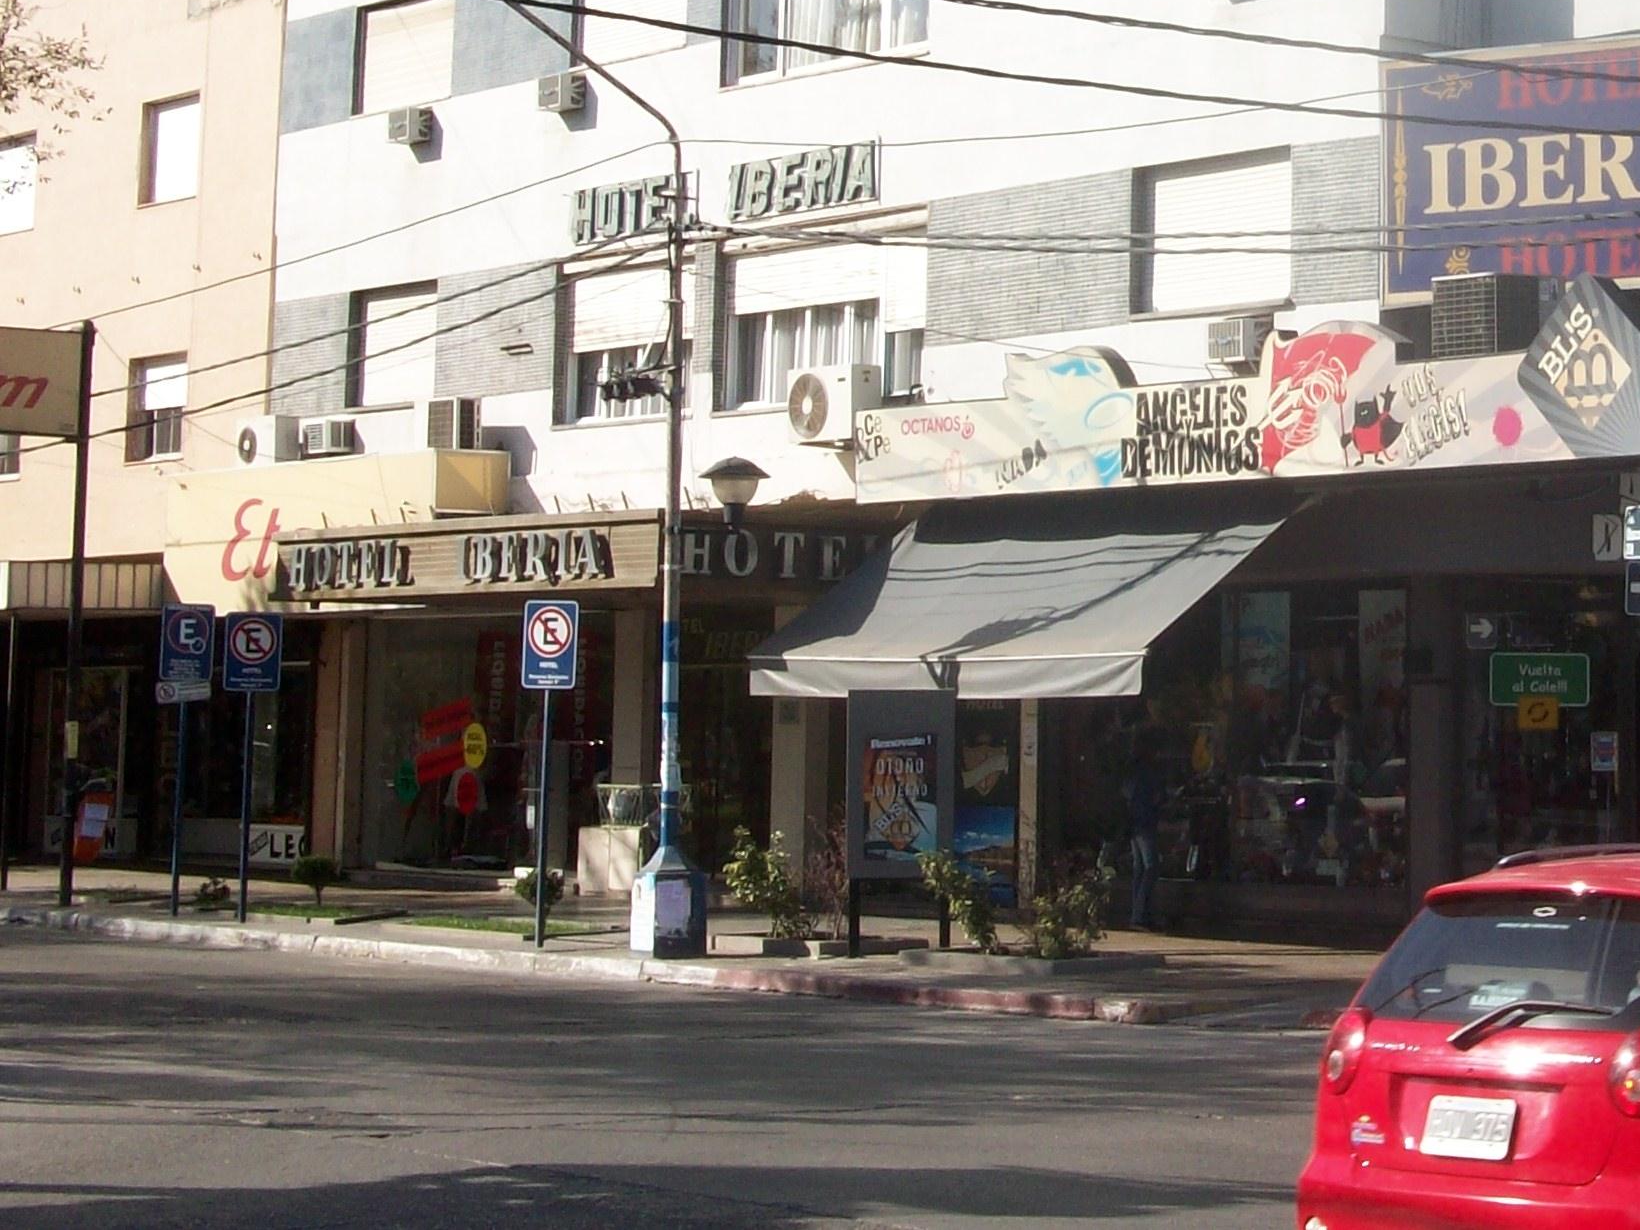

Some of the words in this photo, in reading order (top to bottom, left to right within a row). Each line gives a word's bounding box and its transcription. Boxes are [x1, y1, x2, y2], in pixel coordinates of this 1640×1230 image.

[728, 140, 877, 222] IBERIA
[1538, 303, 1592, 384] BL'S
[901, 416, 961, 436] OCTANOS
[1136, 384, 1248, 437] ANGELES
[1121, 426, 1262, 478] DEMONIOS
[288, 538, 405, 589] HOTEL
[457, 528, 602, 583] IBERIA
[680, 527, 880, 581] HOTE
[1512, 681, 1524, 693] al
[1519, 663, 1562, 677] Vuelta
[1473, 1112, 1511, 1142] 375
